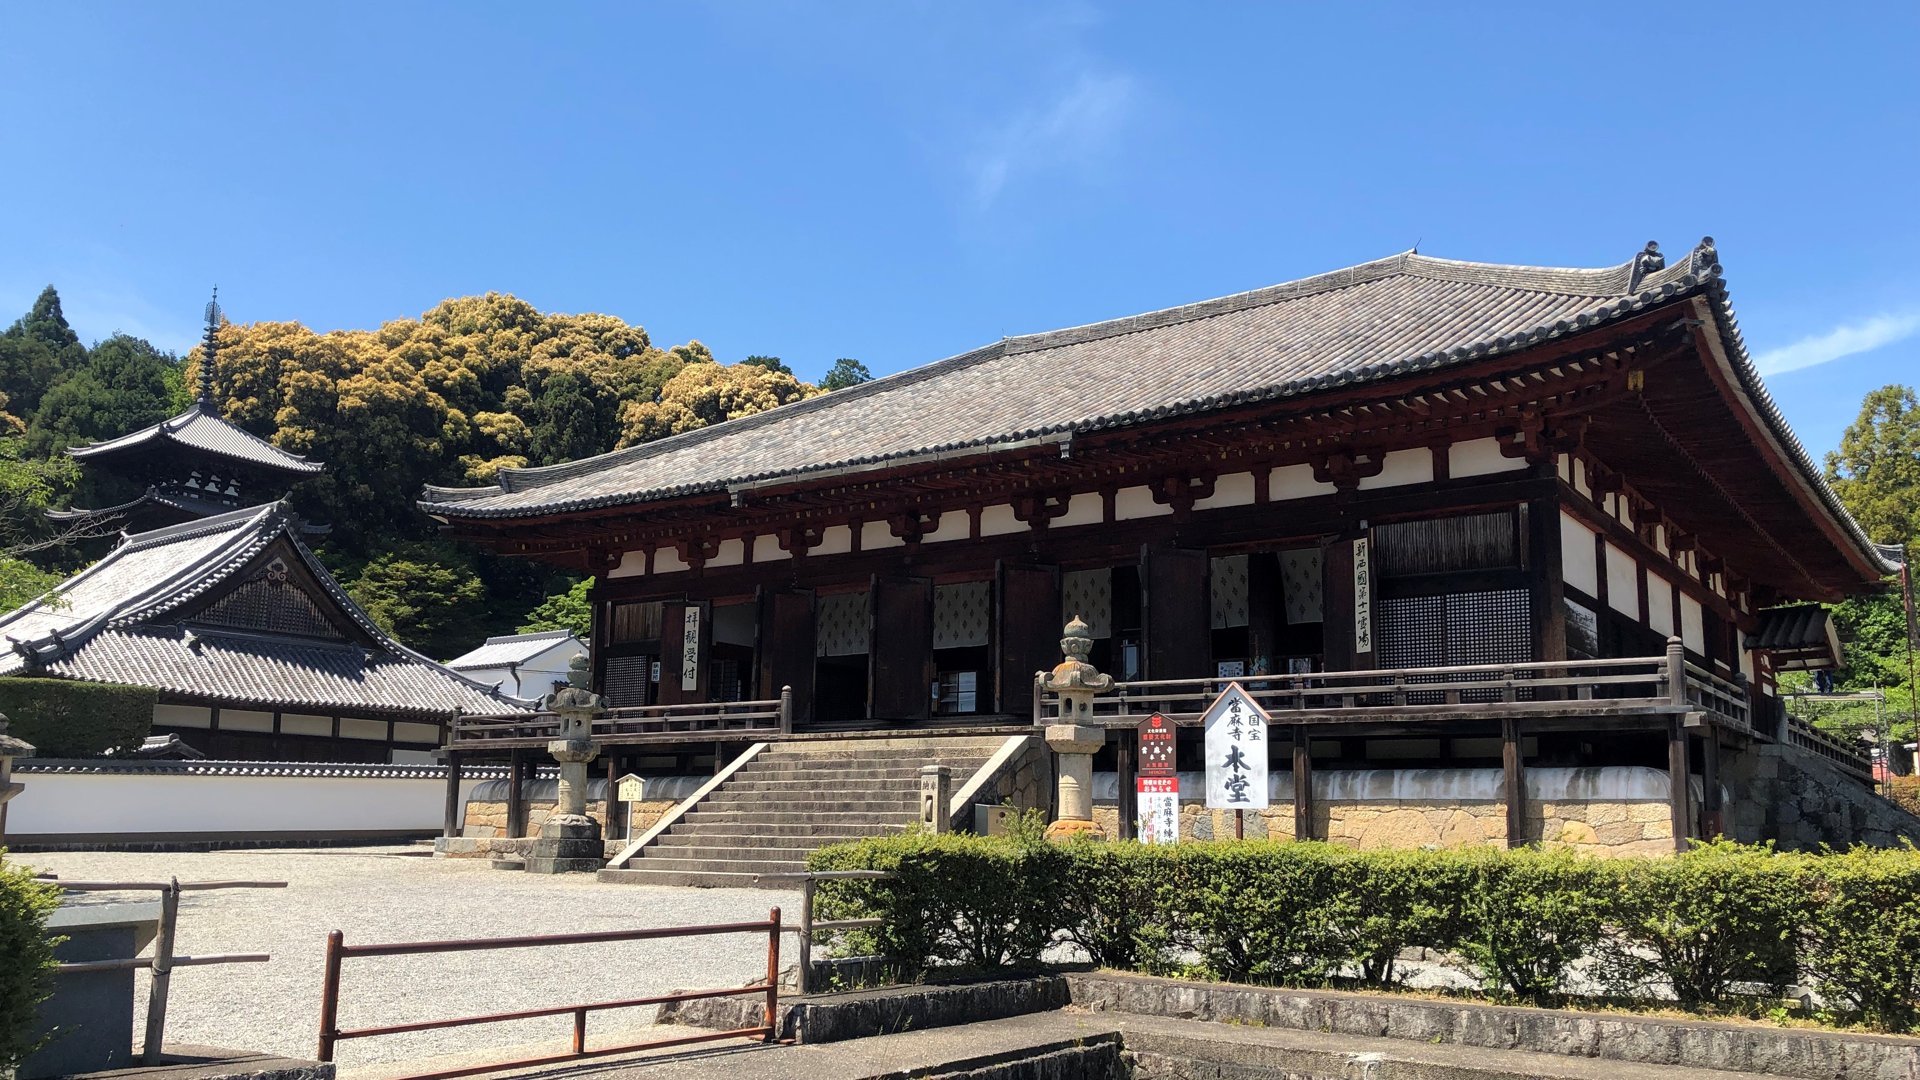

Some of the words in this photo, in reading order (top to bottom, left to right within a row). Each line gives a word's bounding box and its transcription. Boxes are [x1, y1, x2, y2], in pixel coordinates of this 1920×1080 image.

[1226, 696, 1244, 742] 當麻寺
[1247, 714, 1262, 741] 国宝
[1144, 785, 1172, 793] お知らせ
[1221, 744, 1252, 803] 本堂
